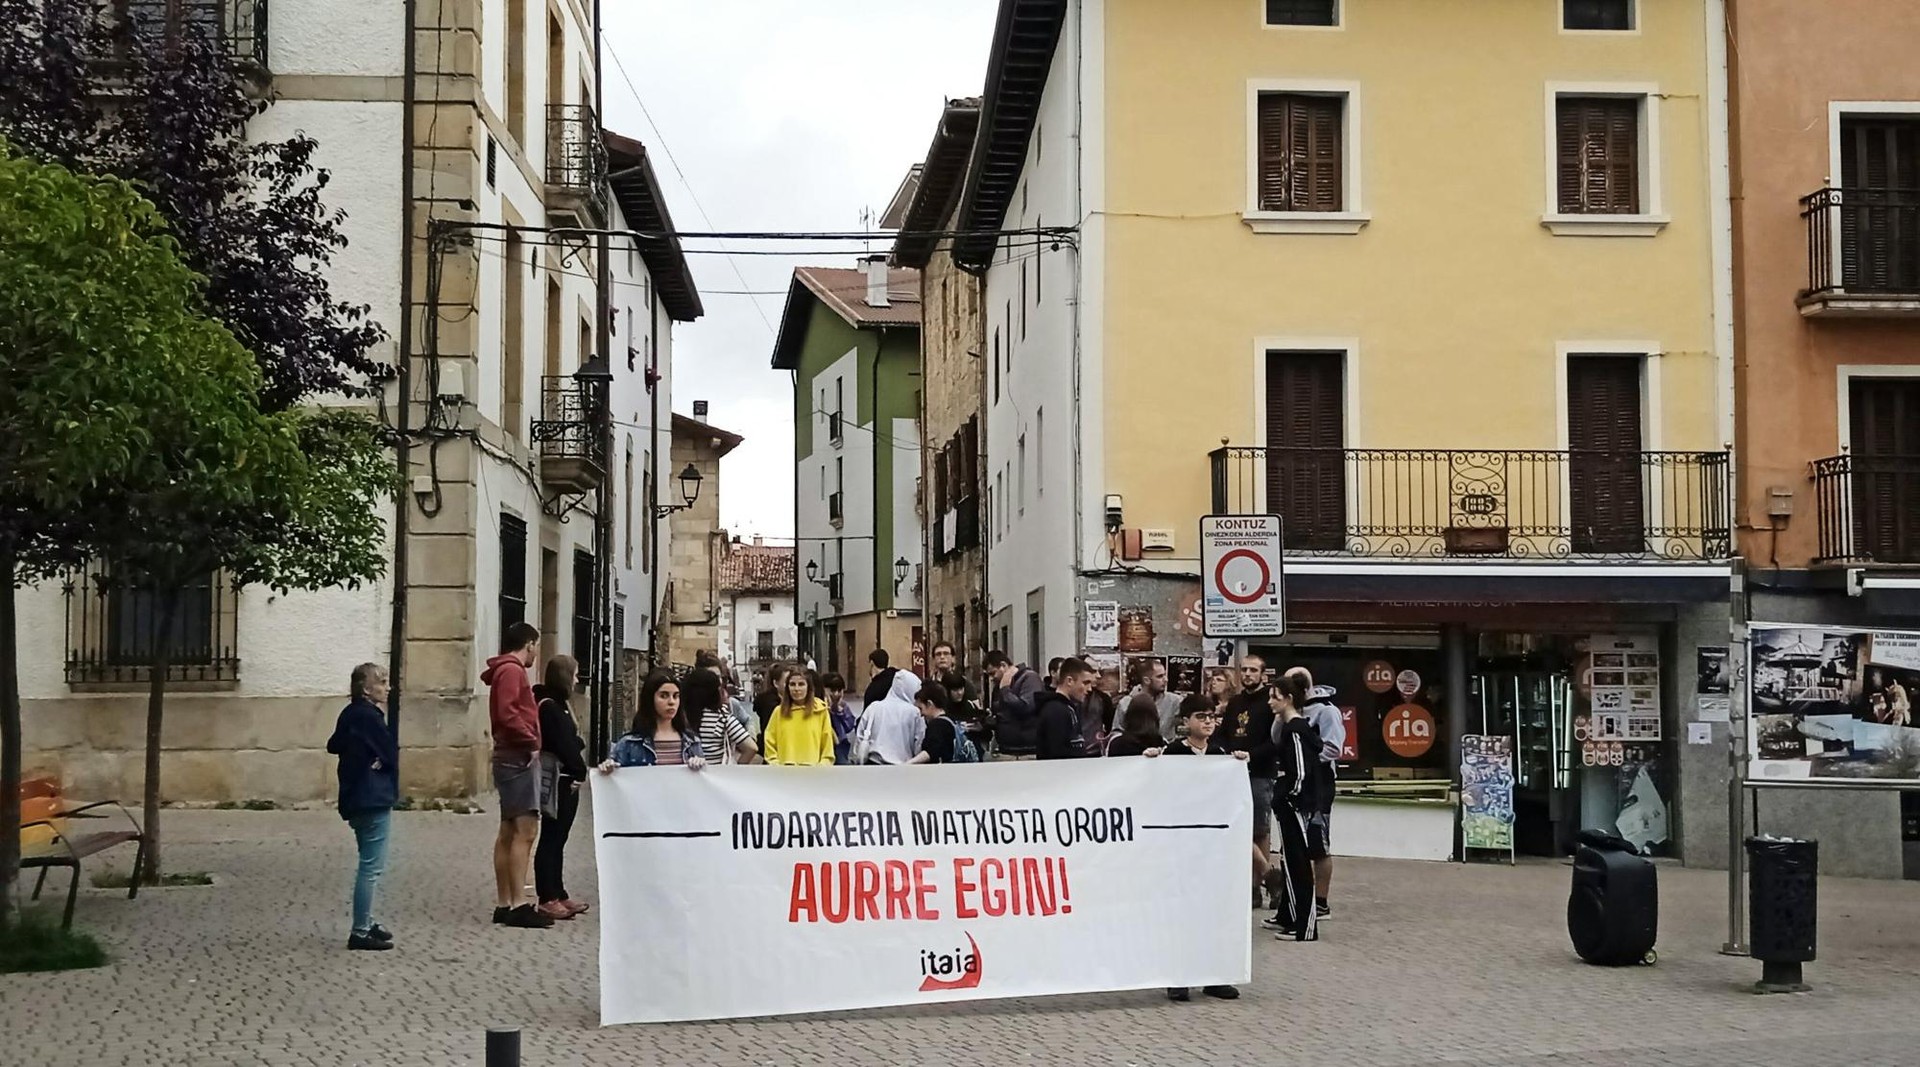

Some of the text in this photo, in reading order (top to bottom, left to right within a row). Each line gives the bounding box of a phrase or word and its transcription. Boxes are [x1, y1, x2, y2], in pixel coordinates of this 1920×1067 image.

[1215, 519, 1267, 530] KONTUZ
[1367, 664, 1392, 681] ria
[1389, 710, 1429, 737] ria
[732, 806, 1134, 850] INDARKERIA MATXISTA ORORI
[788, 856, 1072, 923] AURRE EGIN!
[920, 948, 978, 976] itaia
